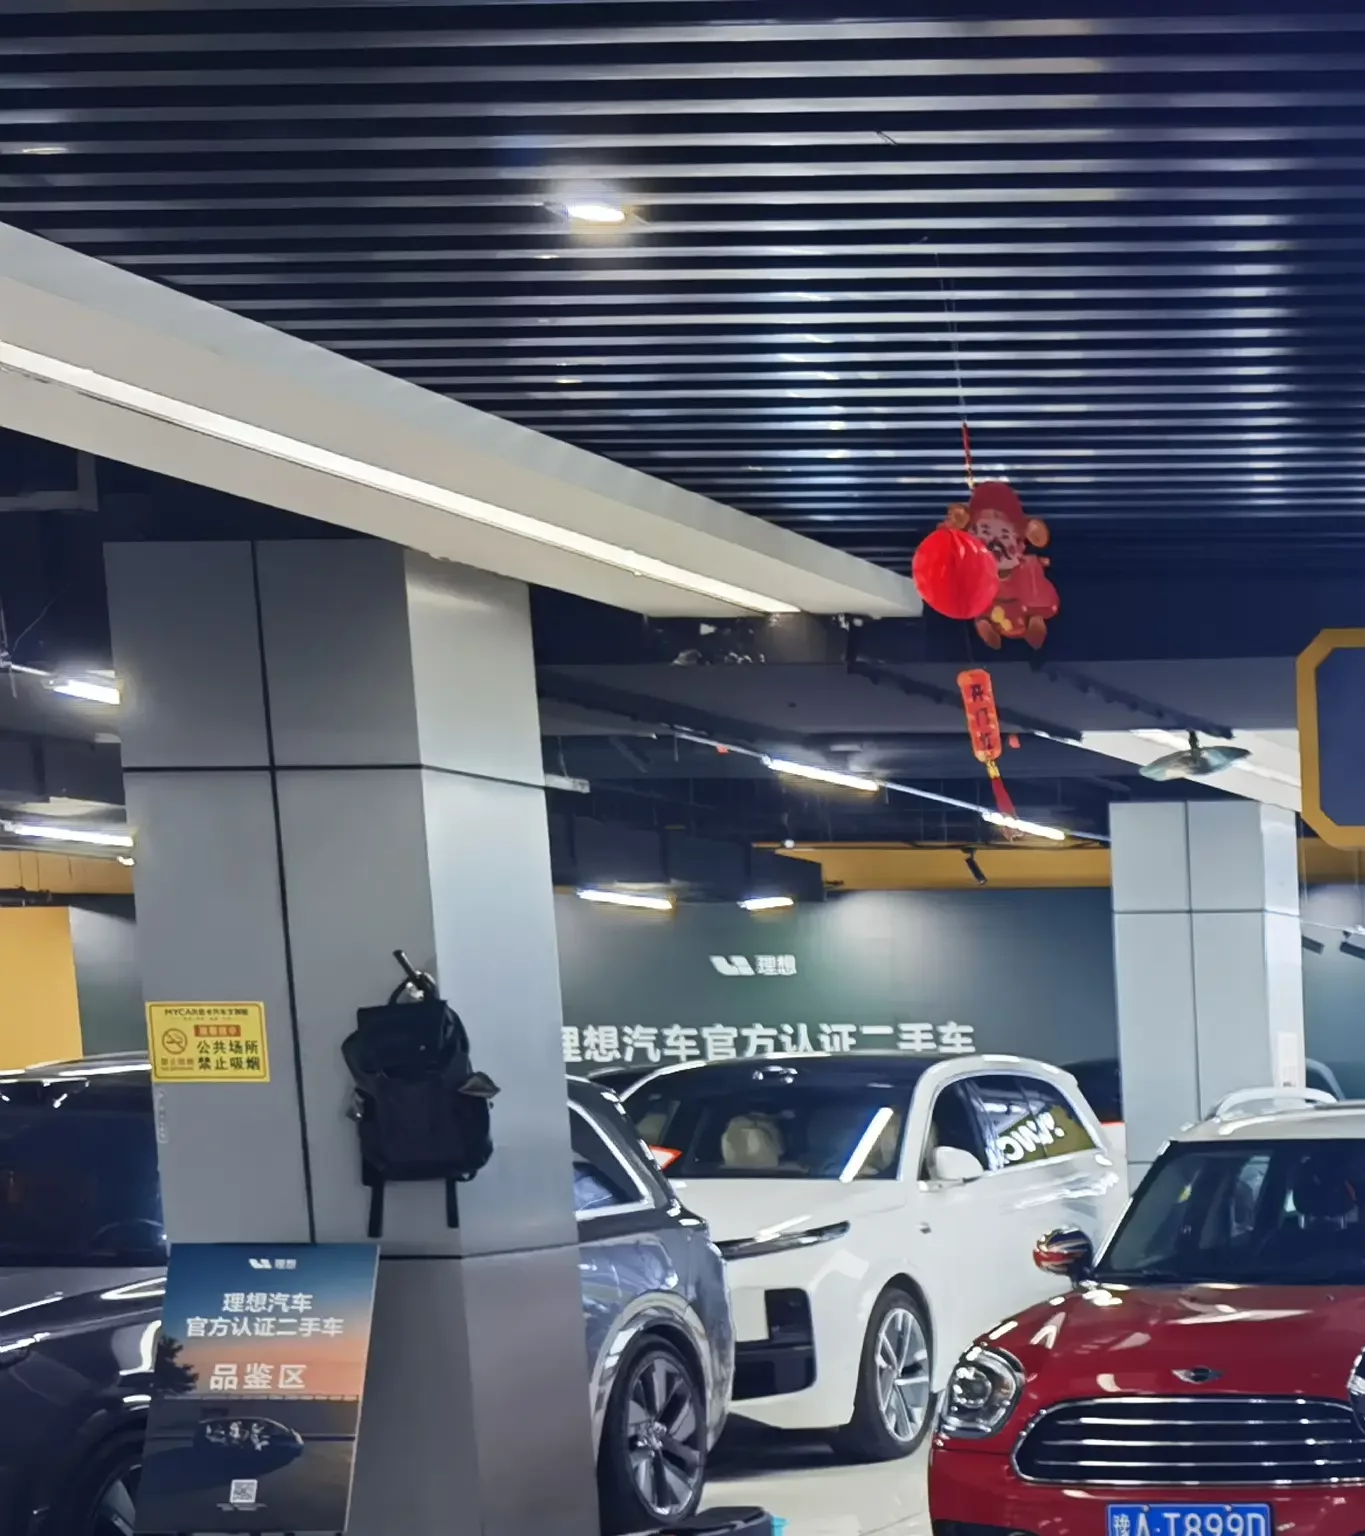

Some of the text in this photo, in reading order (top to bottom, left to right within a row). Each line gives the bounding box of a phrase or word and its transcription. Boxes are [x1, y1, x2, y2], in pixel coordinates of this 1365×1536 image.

[197, 1040, 259, 1055] 公共场所
[198, 1056, 261, 1071] 禁止吸烟
[222, 1292, 314, 1313] 理想汽车
[186, 1316, 345, 1338] 官方认证二手车
[209, 1363, 308, 1391] 品鉴区
